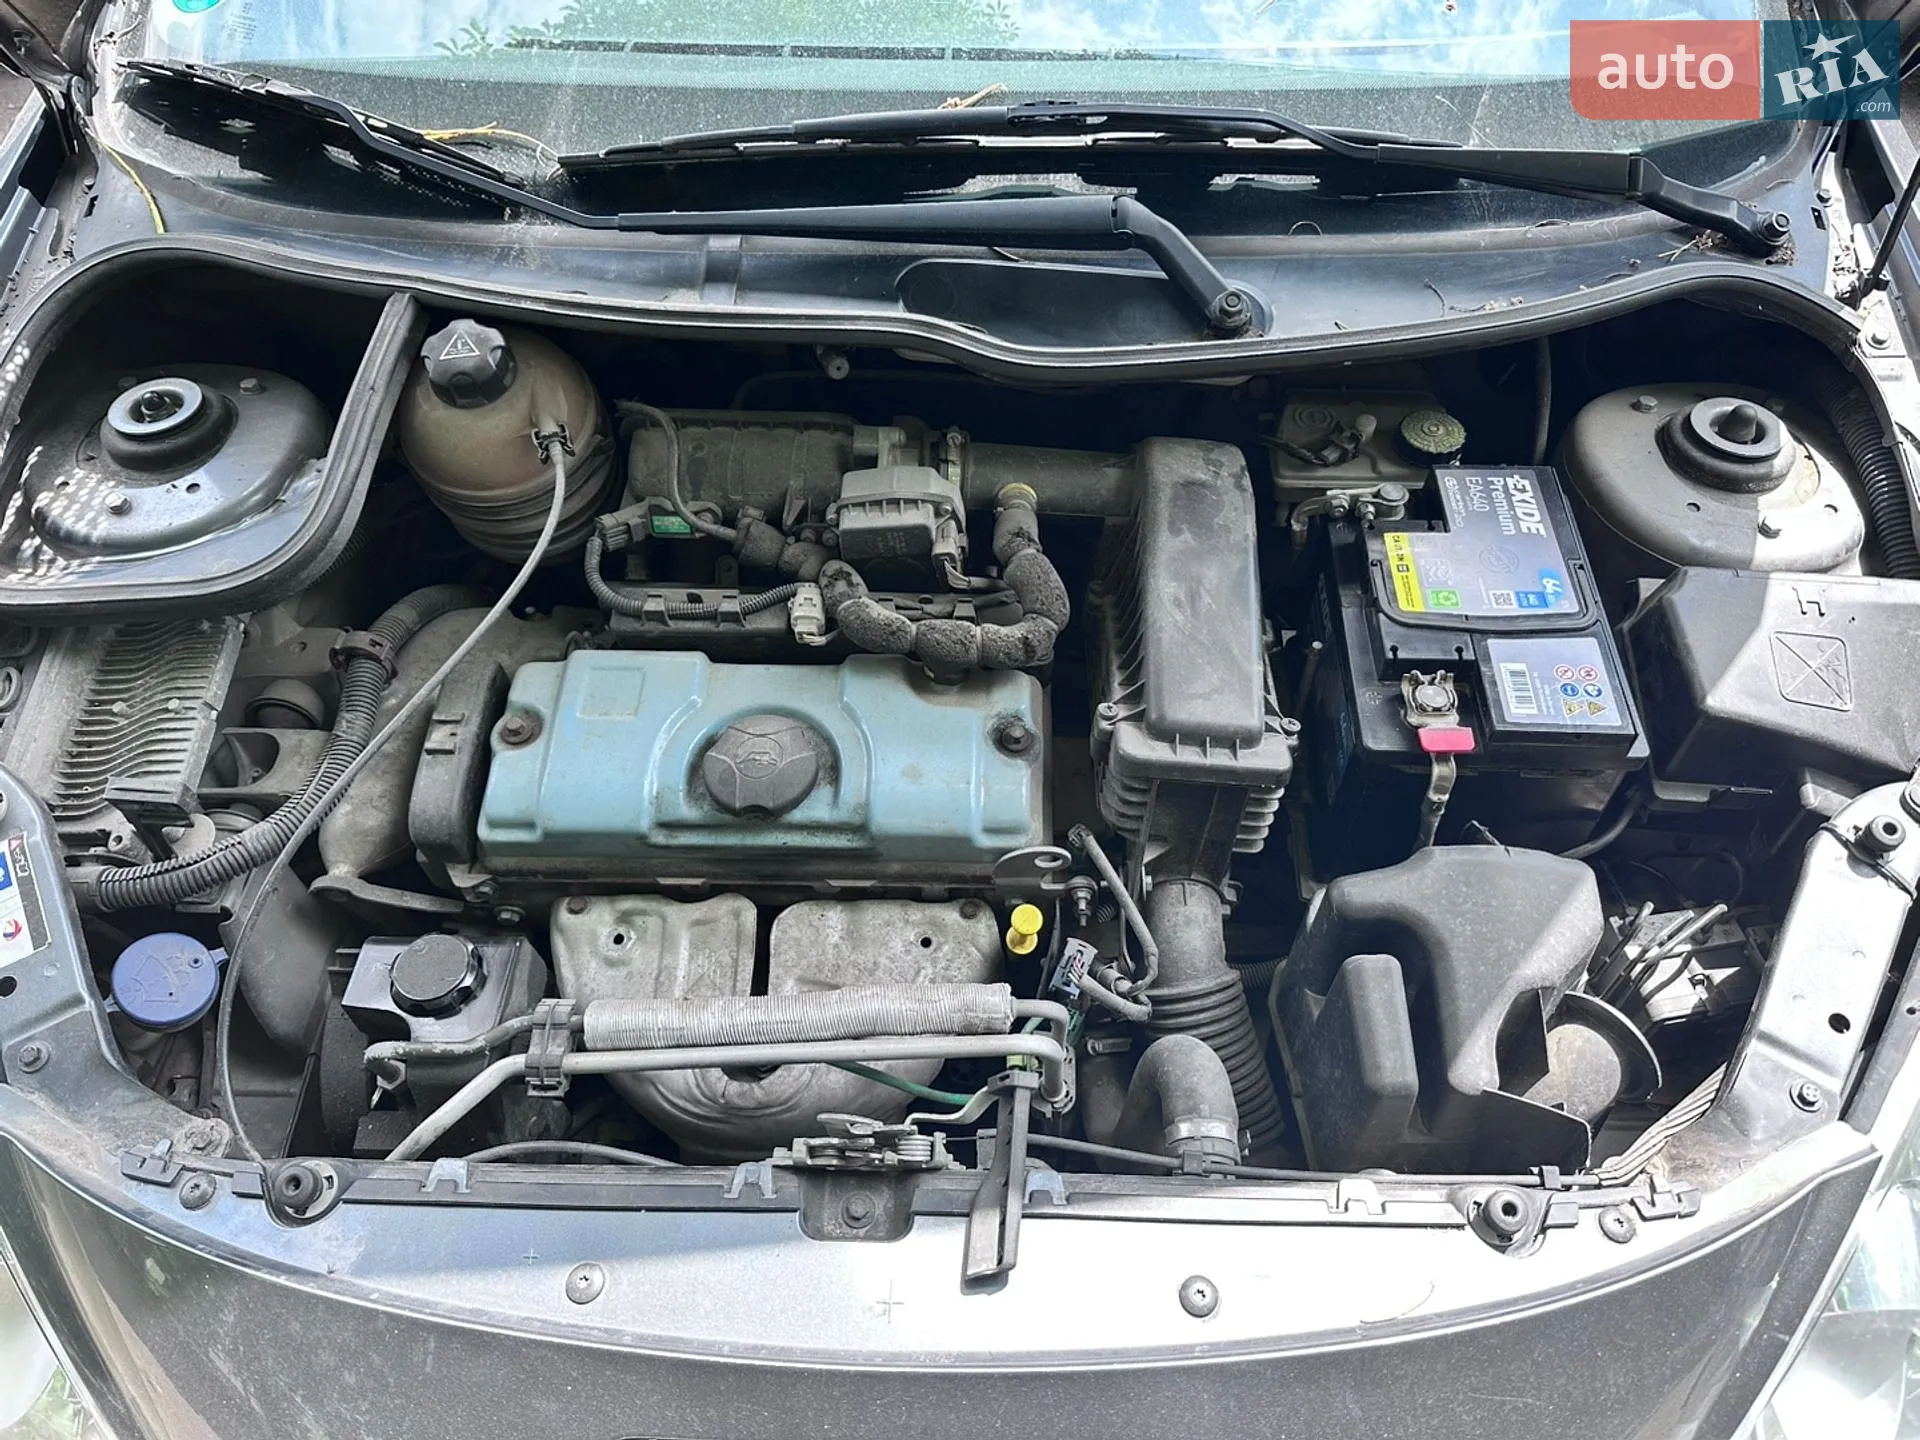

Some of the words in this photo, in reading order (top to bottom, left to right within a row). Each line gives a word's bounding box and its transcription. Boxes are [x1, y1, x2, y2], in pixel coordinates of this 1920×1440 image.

[1465, 477, 1490, 512] EA640
[1487, 477, 1516, 535] Premium
[1506, 475, 1546, 537] EXIDE
